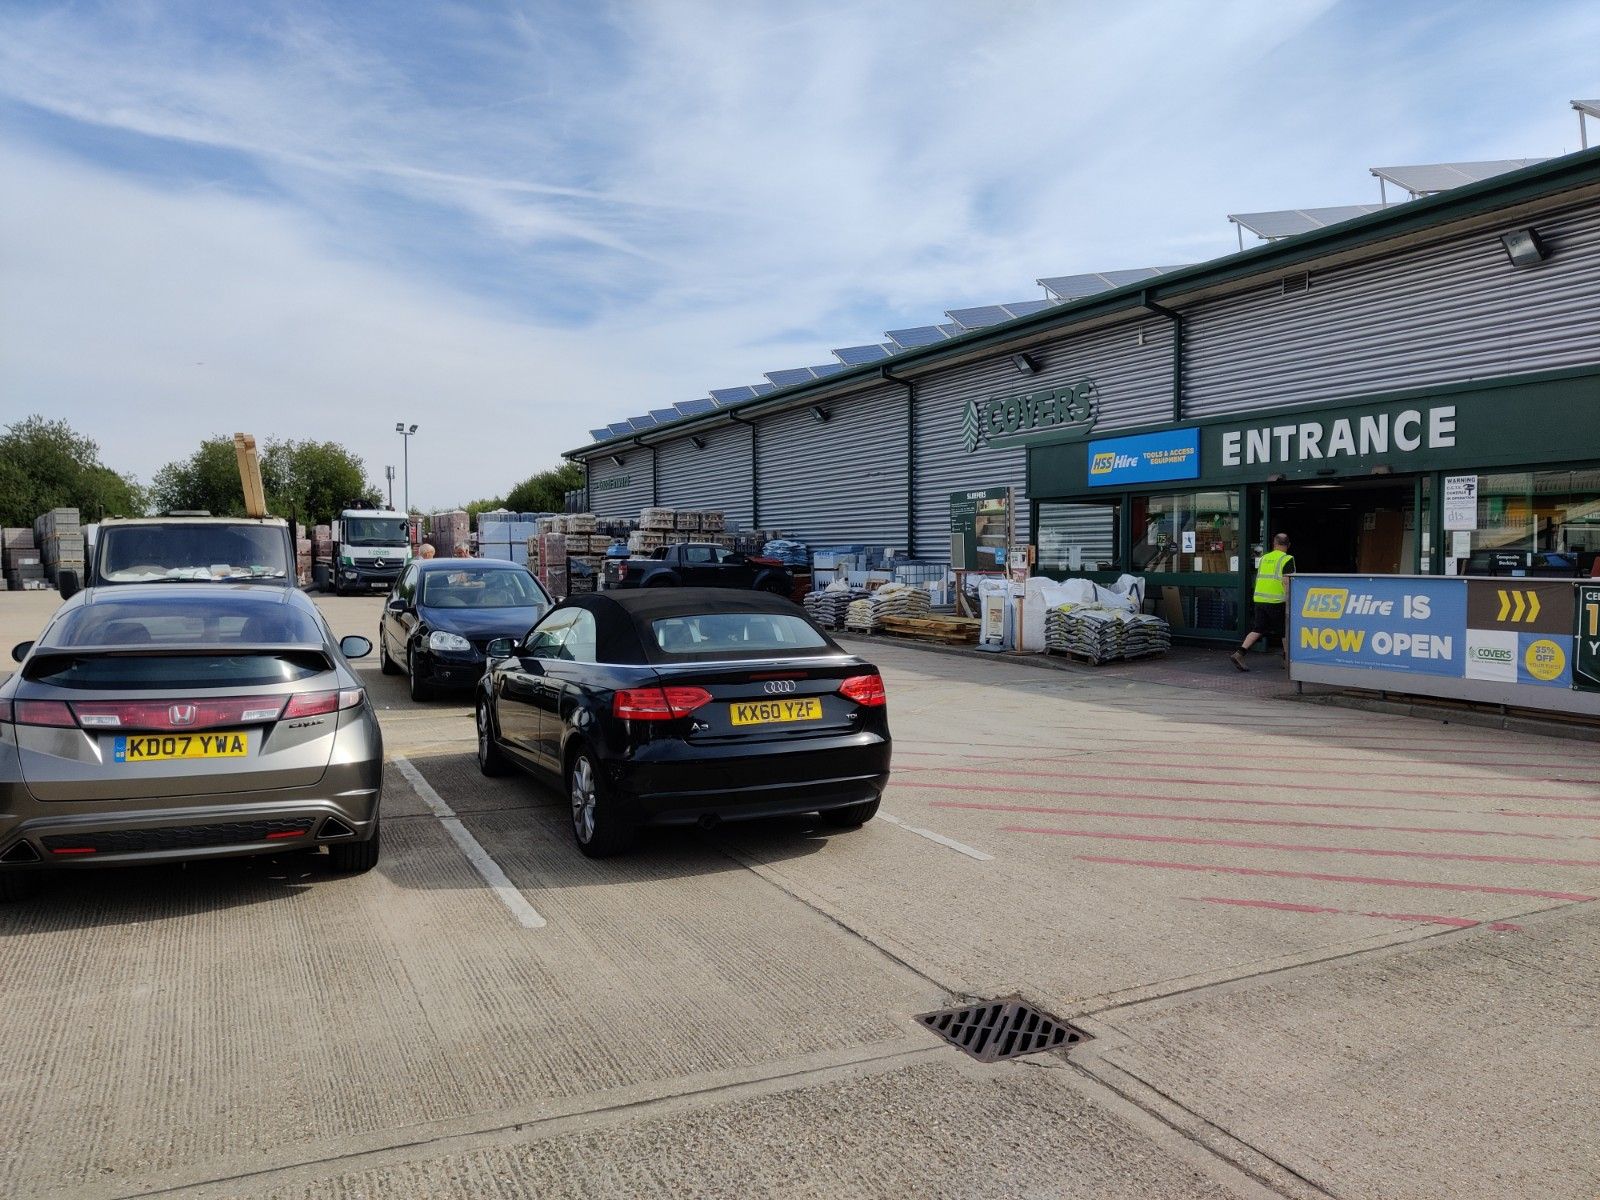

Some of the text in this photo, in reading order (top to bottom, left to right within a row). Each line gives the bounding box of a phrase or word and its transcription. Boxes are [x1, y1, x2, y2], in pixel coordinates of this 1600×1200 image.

[985, 382, 1091, 435] COVERS
[1222, 405, 1456, 467] ENTRANCE
[1093, 454, 1139, 470] HSS Hire
[1142, 450, 1163, 459] TOOLS
[1169, 447, 1195, 456] ACCESS
[1150, 455, 1186, 465] EQUIPMENT
[966, 491, 987, 500] SLEEPERS
[1307, 593, 1431, 620] HSS Hire IS
[1301, 627, 1453, 661] NOW OPEN
[1477, 648, 1512, 659] COVERS
[1535, 654, 1555, 662] OFF
[737, 701, 814, 722] KX60 YZF
[129, 734, 244, 758] KD07 YWA
